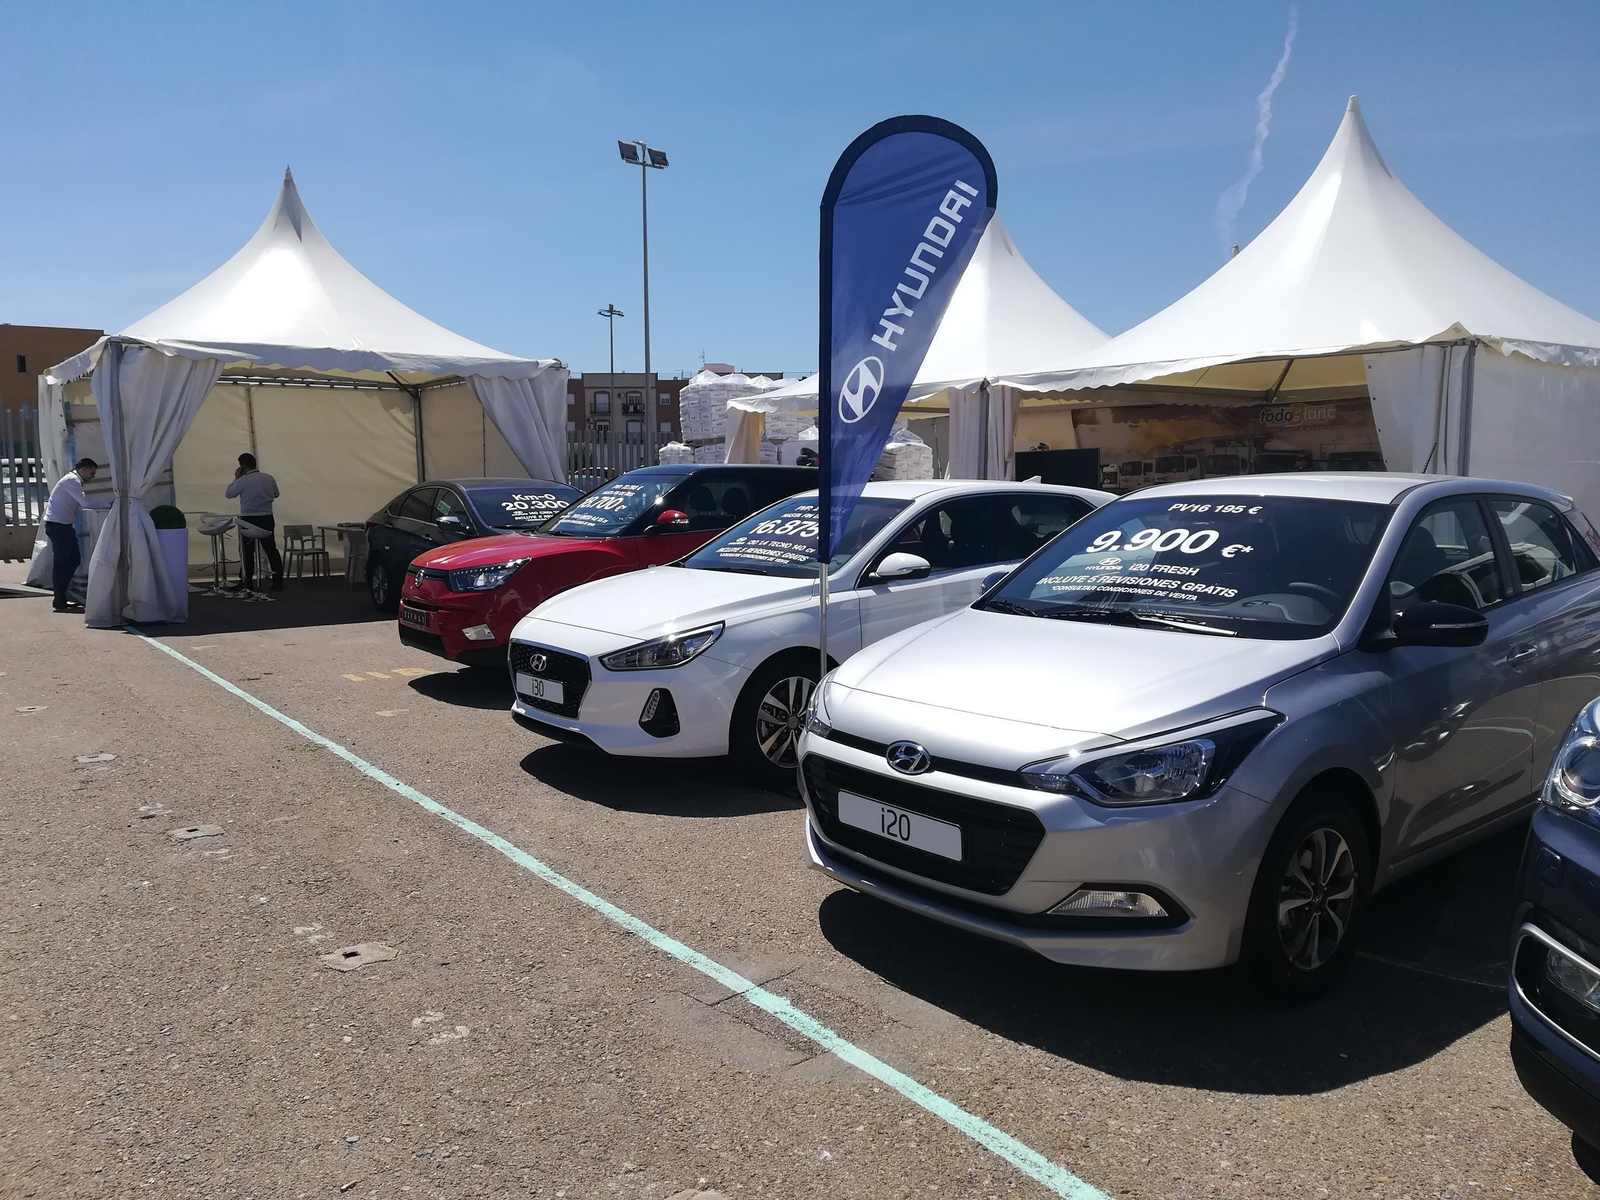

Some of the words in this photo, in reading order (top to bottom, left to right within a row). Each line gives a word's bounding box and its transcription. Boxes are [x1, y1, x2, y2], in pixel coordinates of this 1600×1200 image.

[871, 179, 979, 352] HYUNDAI
[501, 500, 570, 511] 20.300
[1214, 504, 1247, 514] 195
[1248, 506, 1263, 515] €
[748, 520, 819, 537] 16.875
[1086, 528, 1220, 554] 9.900
[782, 552, 810, 562] GRATIS
[1128, 562, 1150, 572] i20
[1150, 564, 1201, 577] FRESH
[1035, 575, 1089, 585] INCLUYE
[1087, 575, 1099, 583] 5
[1098, 575, 1181, 590] REVISIONES
[1180, 581, 1239, 599] GRATIS
[1096, 585, 1155, 596] CONDICIONES
[1153, 589, 1167, 598] DE
[1167, 591, 1199, 602] VENTA
[531, 678, 545, 697] i30
[881, 807, 911, 842] i20
